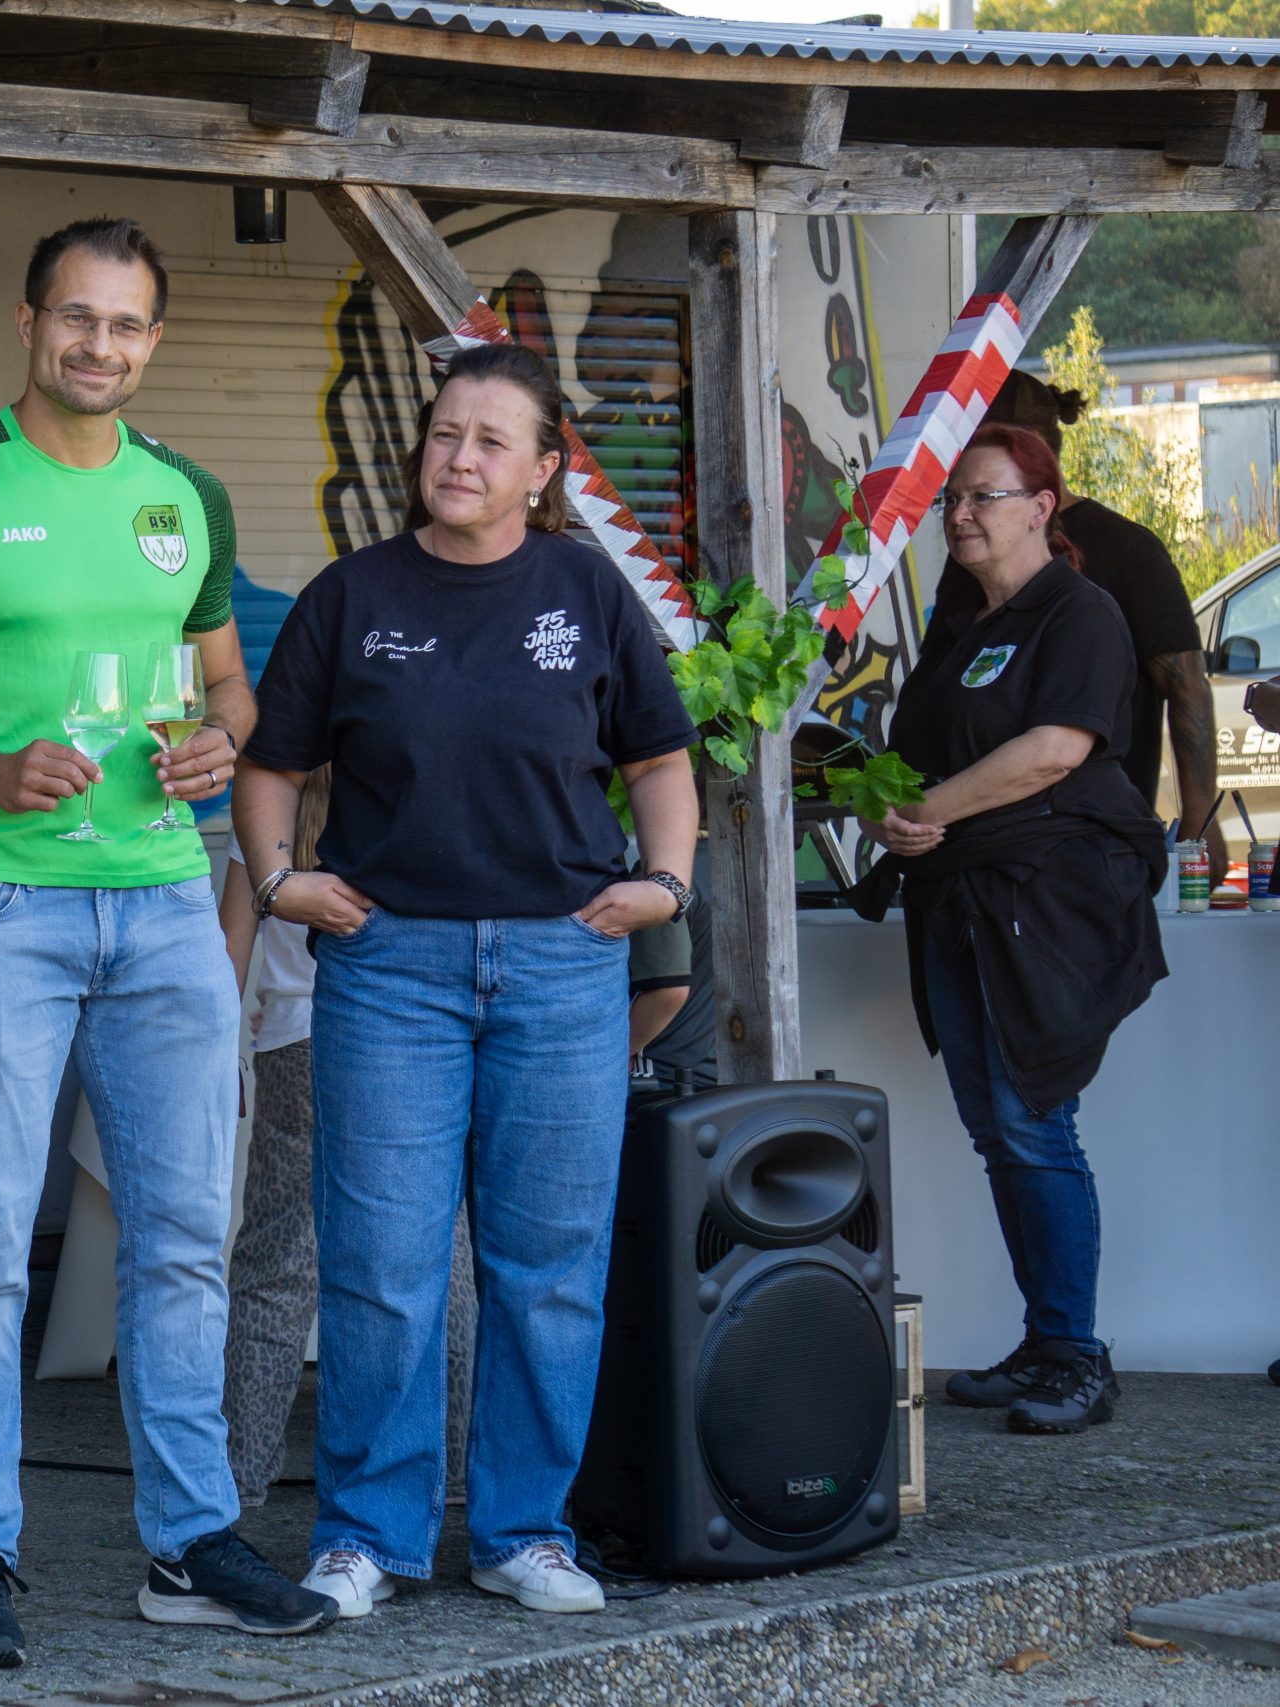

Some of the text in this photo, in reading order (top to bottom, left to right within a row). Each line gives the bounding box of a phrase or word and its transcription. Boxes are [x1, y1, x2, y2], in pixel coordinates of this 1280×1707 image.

[149, 515, 177, 528] ASV
[1, 526, 47, 543] JAKO
[535, 609, 567, 631] 75
[389, 631, 404, 639] THE
[523, 625, 581, 649] JAHRE
[362, 631, 437, 658] Bommel
[533, 643, 573, 661] ASV
[539, 657, 576, 671] WW
